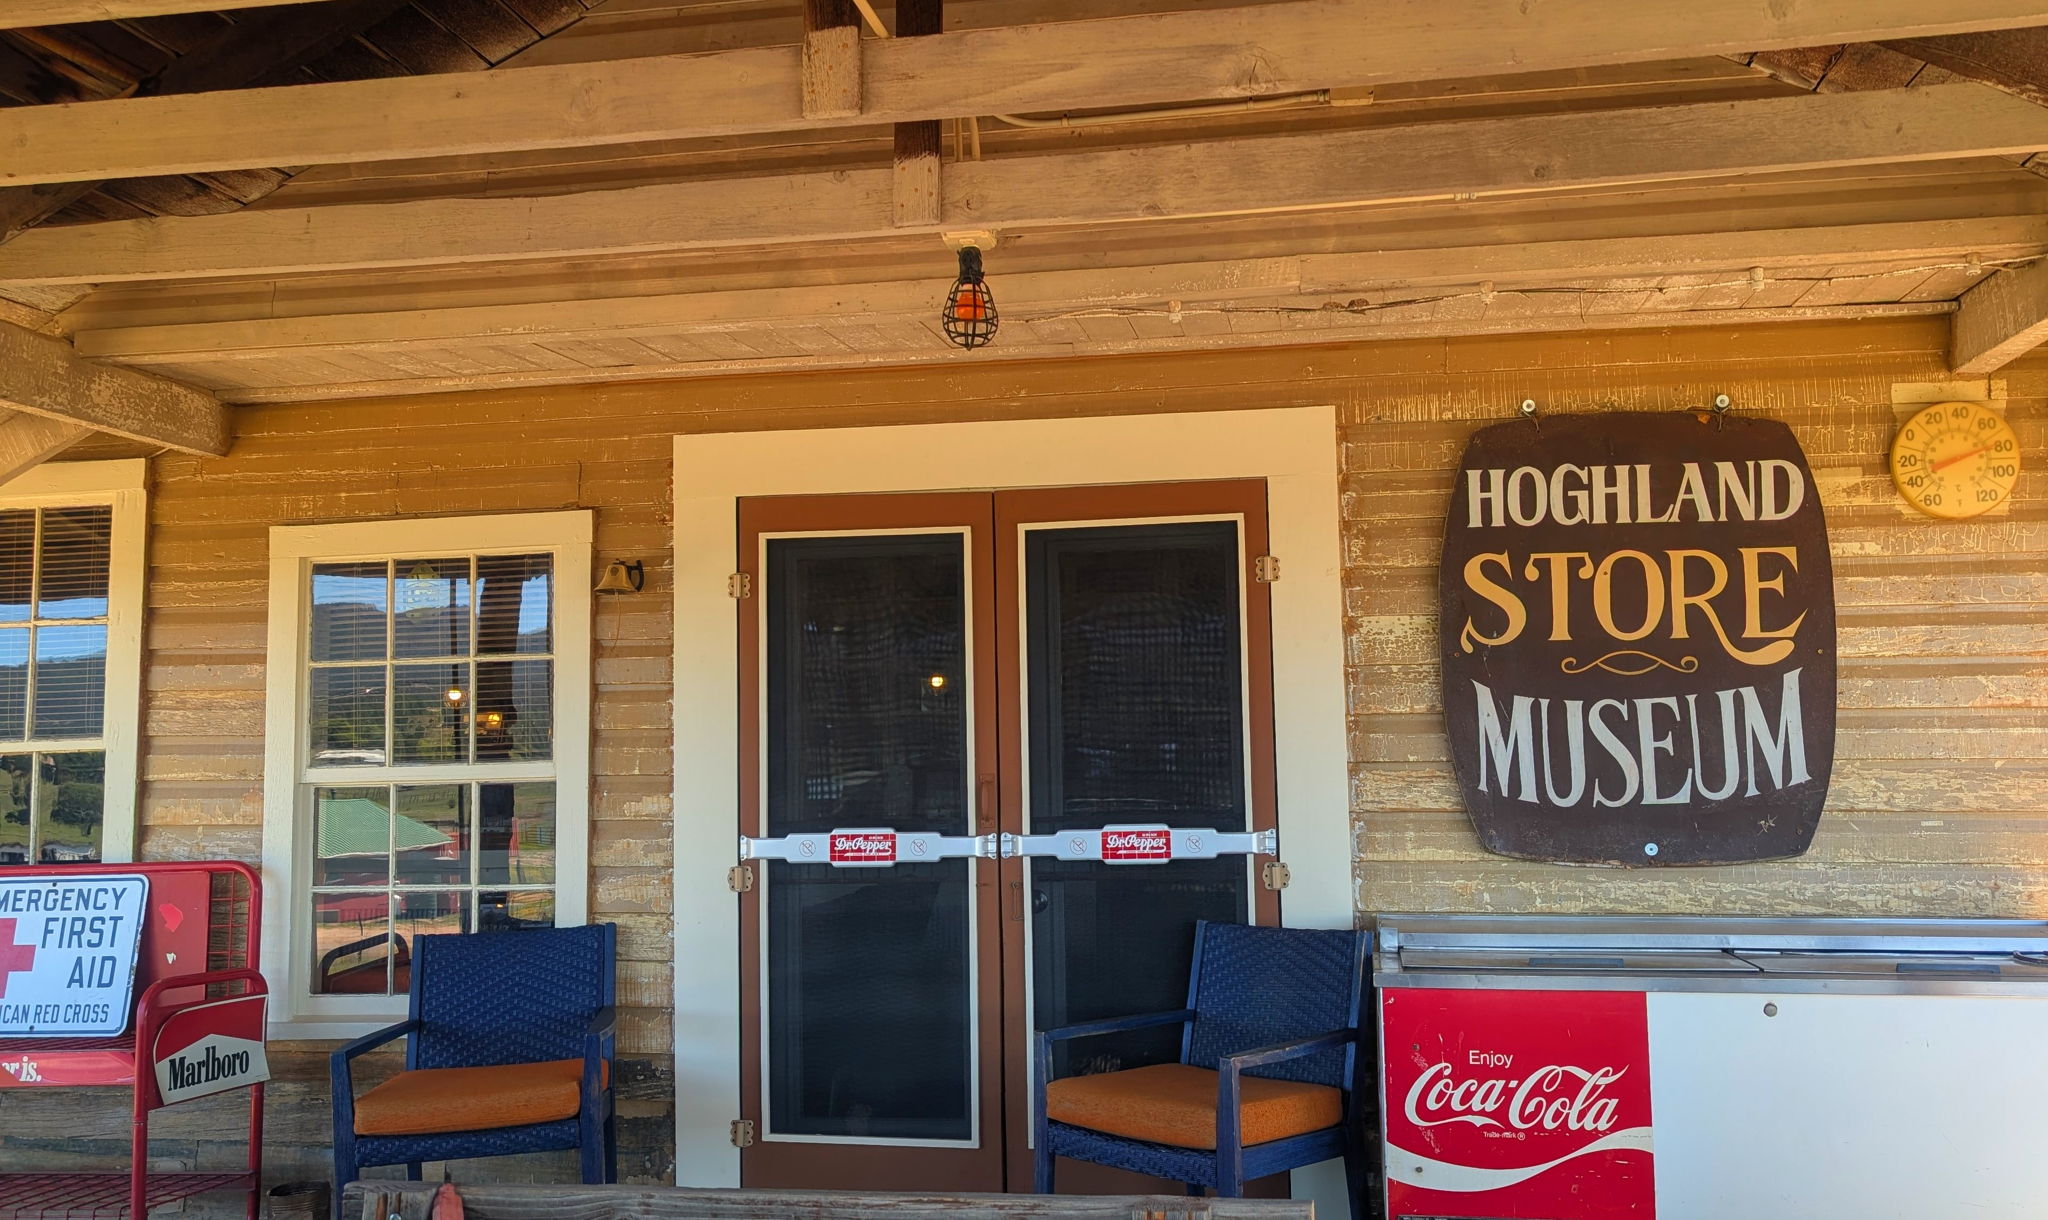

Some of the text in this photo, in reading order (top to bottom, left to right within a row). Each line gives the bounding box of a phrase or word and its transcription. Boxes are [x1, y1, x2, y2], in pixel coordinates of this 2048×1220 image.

[1924, 411, 1943, 425] 20
[1951, 406, 1969, 420] 40
[1977, 417, 1997, 430] 60
[1905, 428, 1915, 441] 0
[1994, 439, 2013, 452] 80
[1897, 454, 1917, 467] -20
[1992, 464, 2015, 477] 100
[1902, 474, 1924, 488] -40
[1466, 459, 1805, 528] HOGHLAND
[1918, 493, 1942, 506] -60
[1976, 489, 1998, 502] 120
[1460, 546, 1808, 666] STORE
[1471, 667, 1812, 808] MUSEUM
[41, 916, 124, 948] FIRST
[66, 957, 117, 989] AID
[33, 1004, 60, 1023] RED
[63, 1004, 110, 1023] CROSS
[1469, 1050, 1513, 1068] Enjoy
[19, 1055, 42, 1082] is.
[168, 1046, 250, 1091] Marlboro
[1404, 1062, 1630, 1131] Coca-Cola
